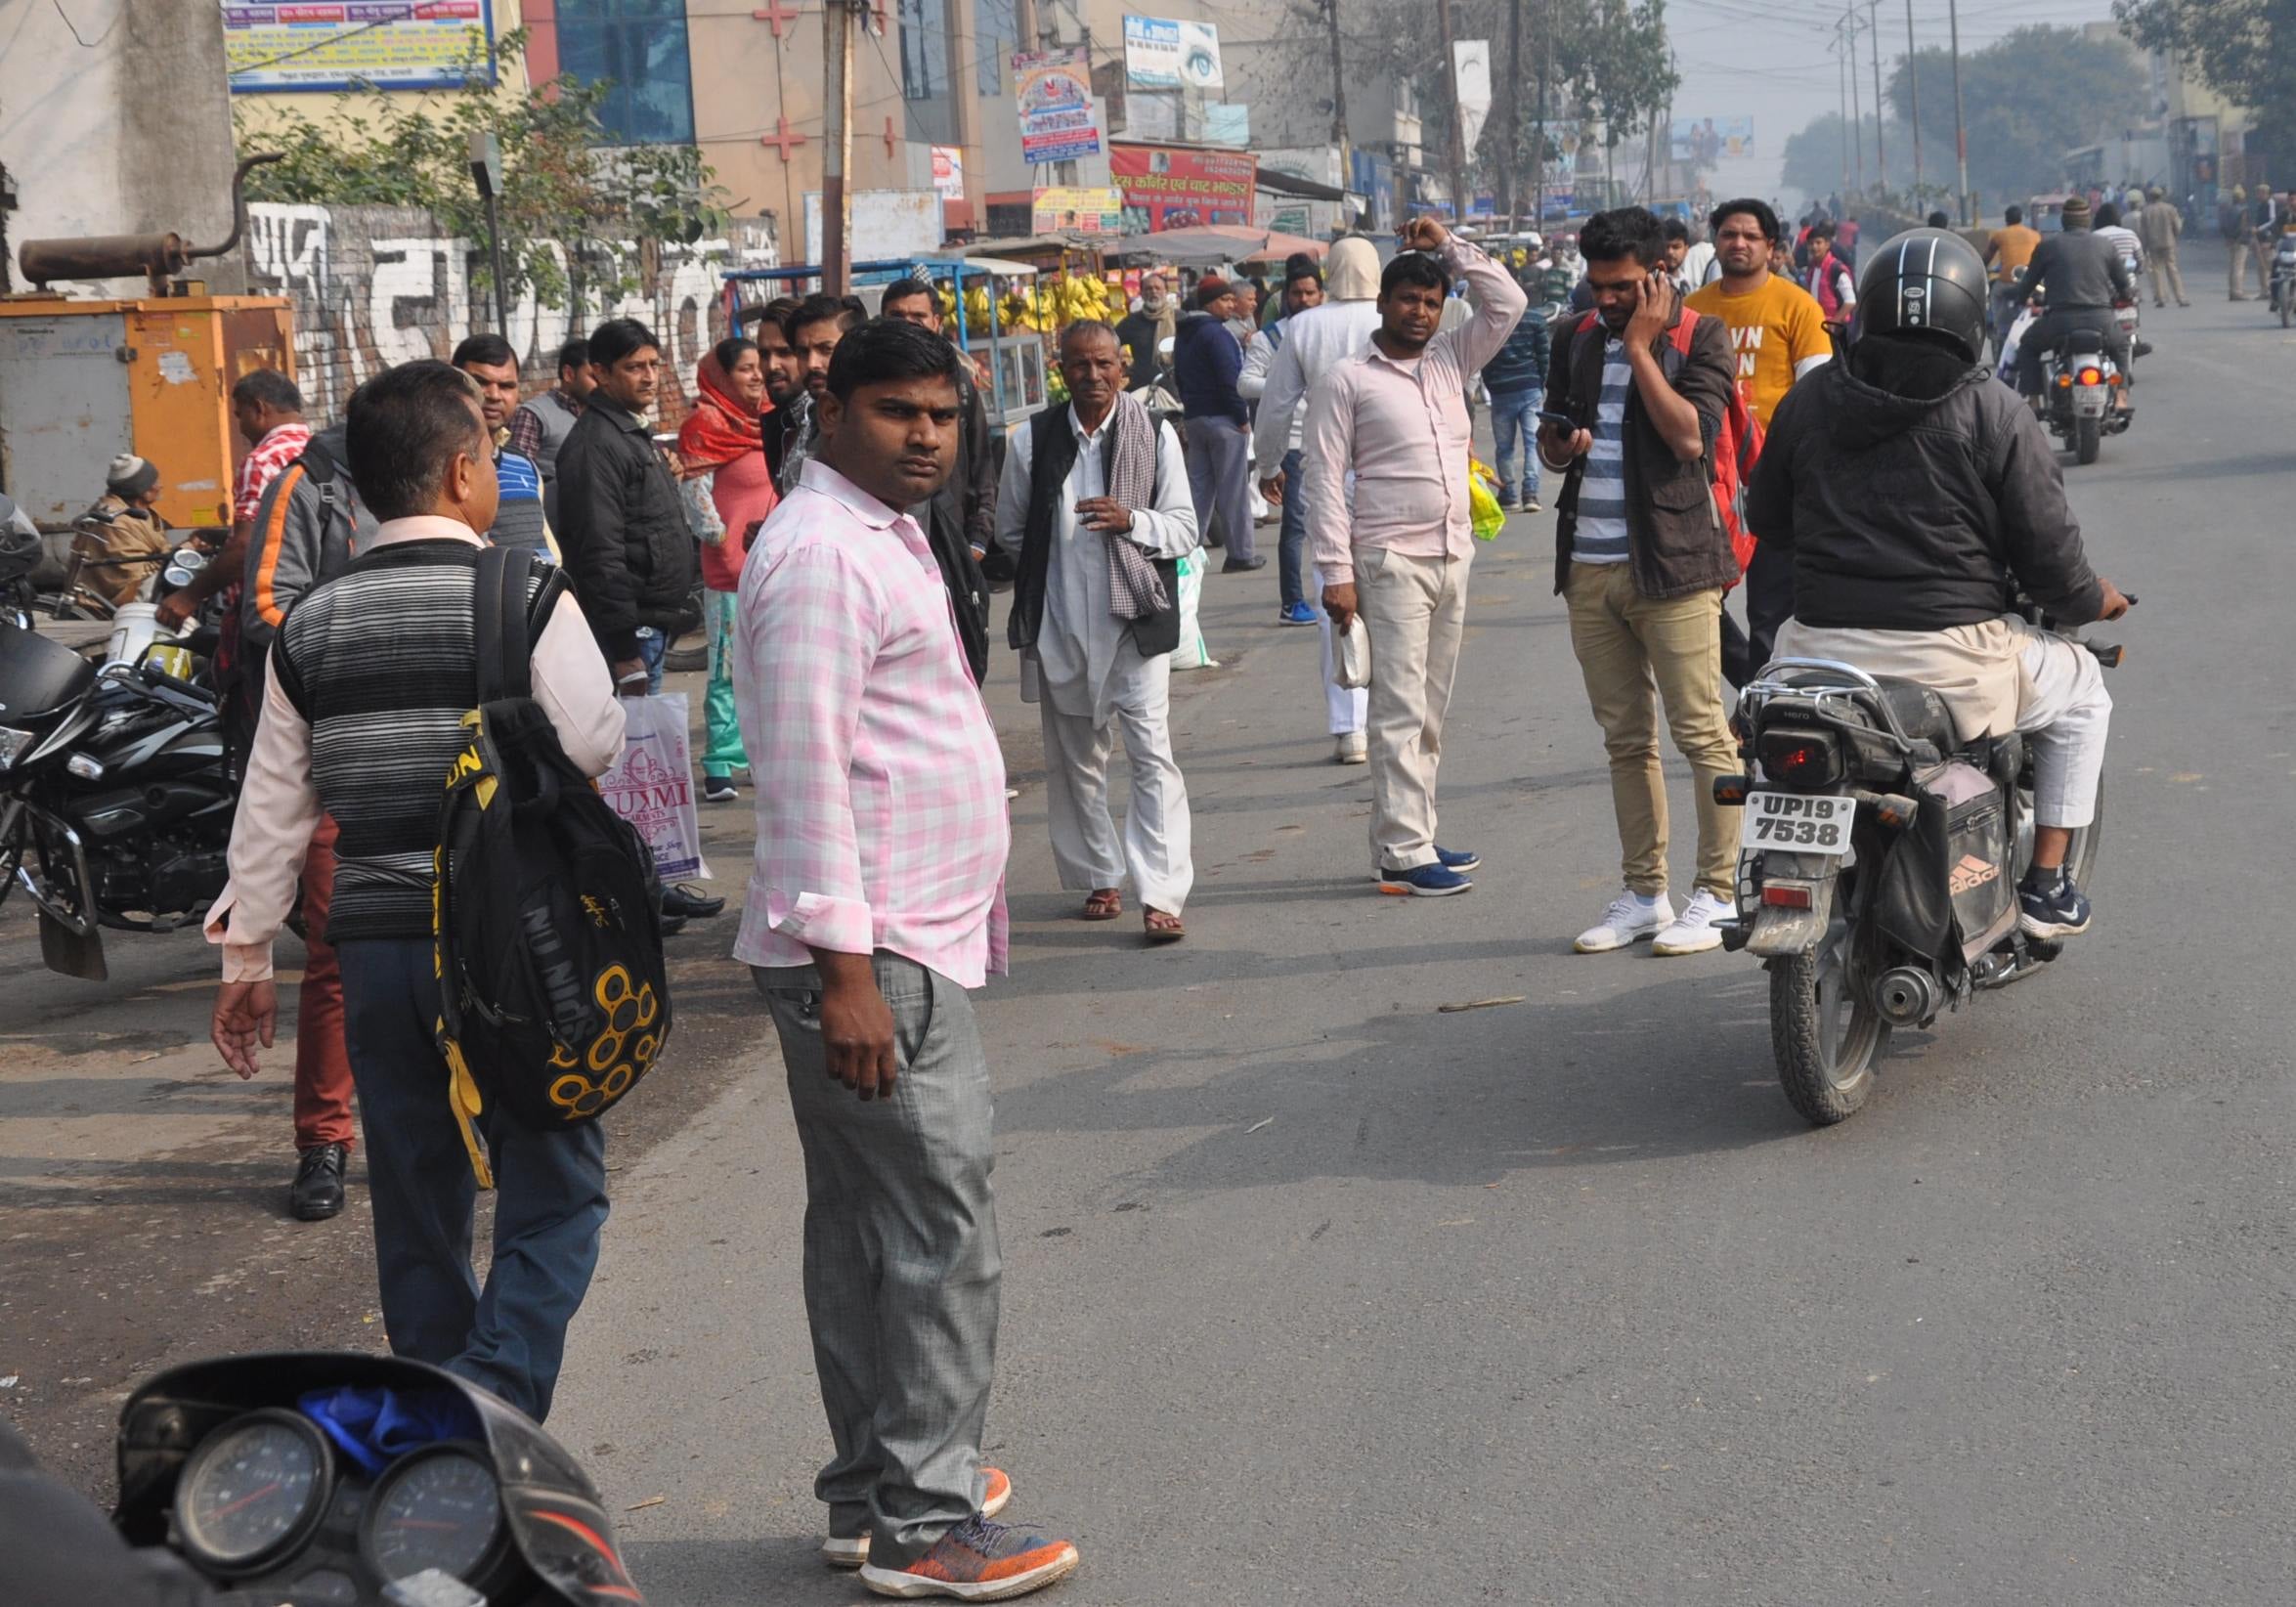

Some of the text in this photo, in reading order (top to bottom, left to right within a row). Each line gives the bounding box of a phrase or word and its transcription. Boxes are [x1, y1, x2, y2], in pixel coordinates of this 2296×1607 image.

[1784, 711, 1810, 720] Hero
[599, 782, 690, 815] UXMI
[1763, 796, 1835, 819] UP19
[1754, 817, 1840, 847] 7538
